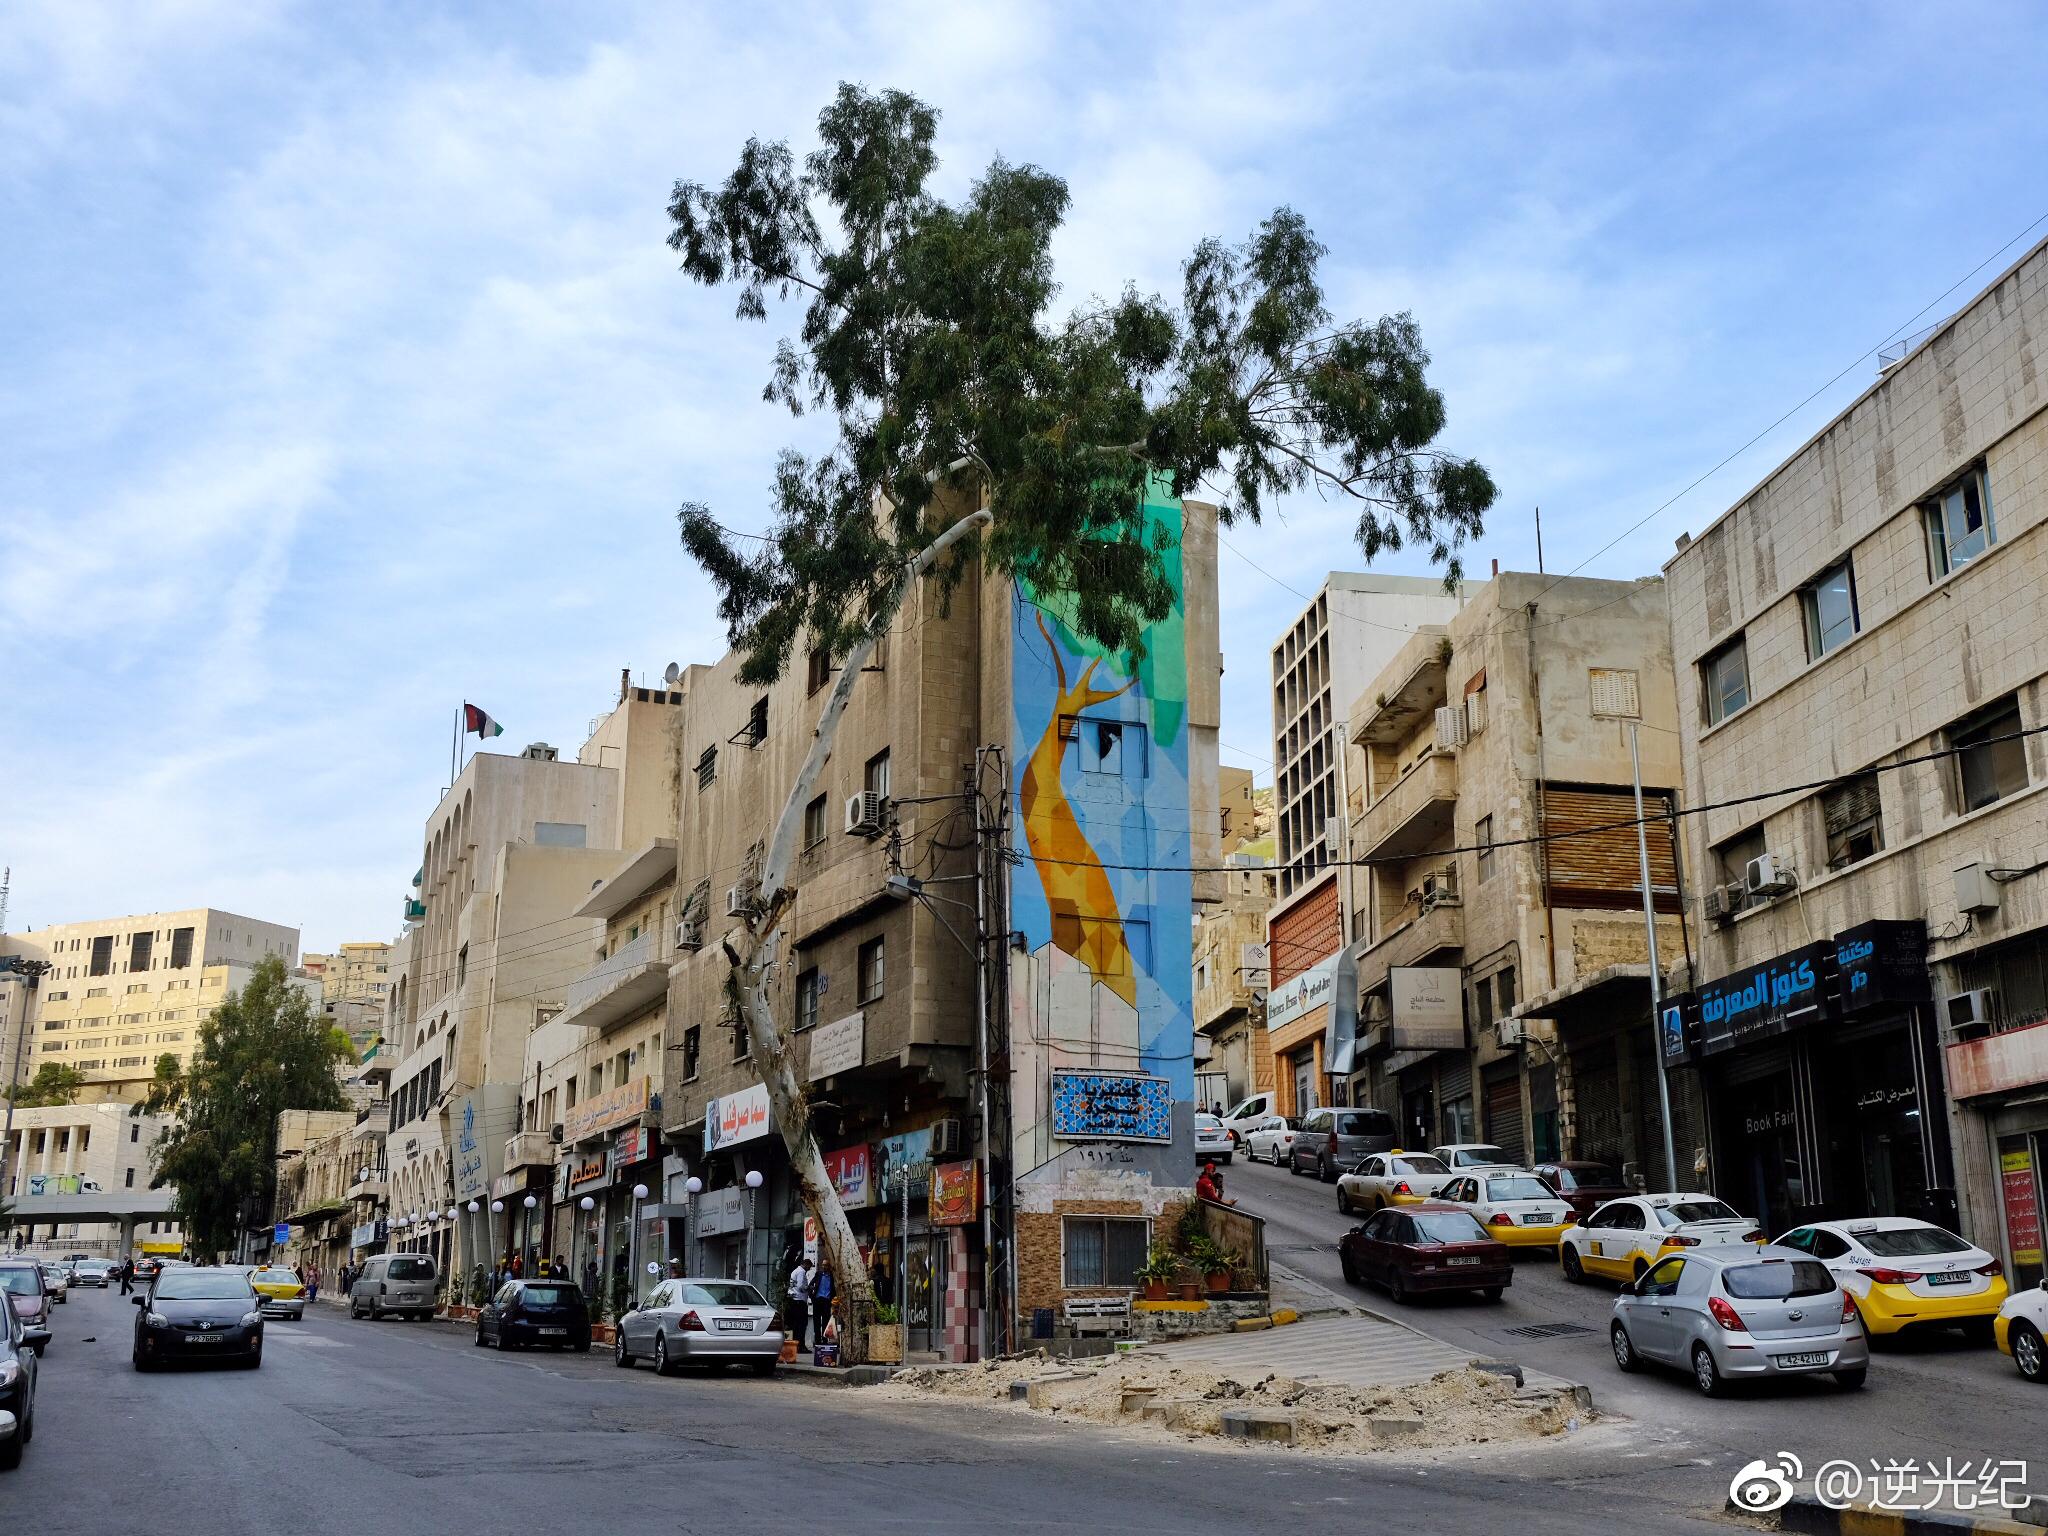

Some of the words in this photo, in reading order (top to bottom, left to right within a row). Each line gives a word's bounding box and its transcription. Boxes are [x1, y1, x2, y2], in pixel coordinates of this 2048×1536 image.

[1838, 940, 1874, 966] مكتبة
[1770, 958, 1816, 1008] كنوز
[1850, 970, 1868, 993] دار
[1702, 971, 1769, 1024] المعرفة
[1746, 1114, 1772, 1134] Book
[1774, 1109, 1795, 1128] Fair
[1080, 1150, 1113, 1162] ١٩١٦
[1120, 1148, 1134, 1162] منذ
[1935, 1271, 1970, 1283] 50-41405
[1786, 1353, 1826, 1365] 42-42107
